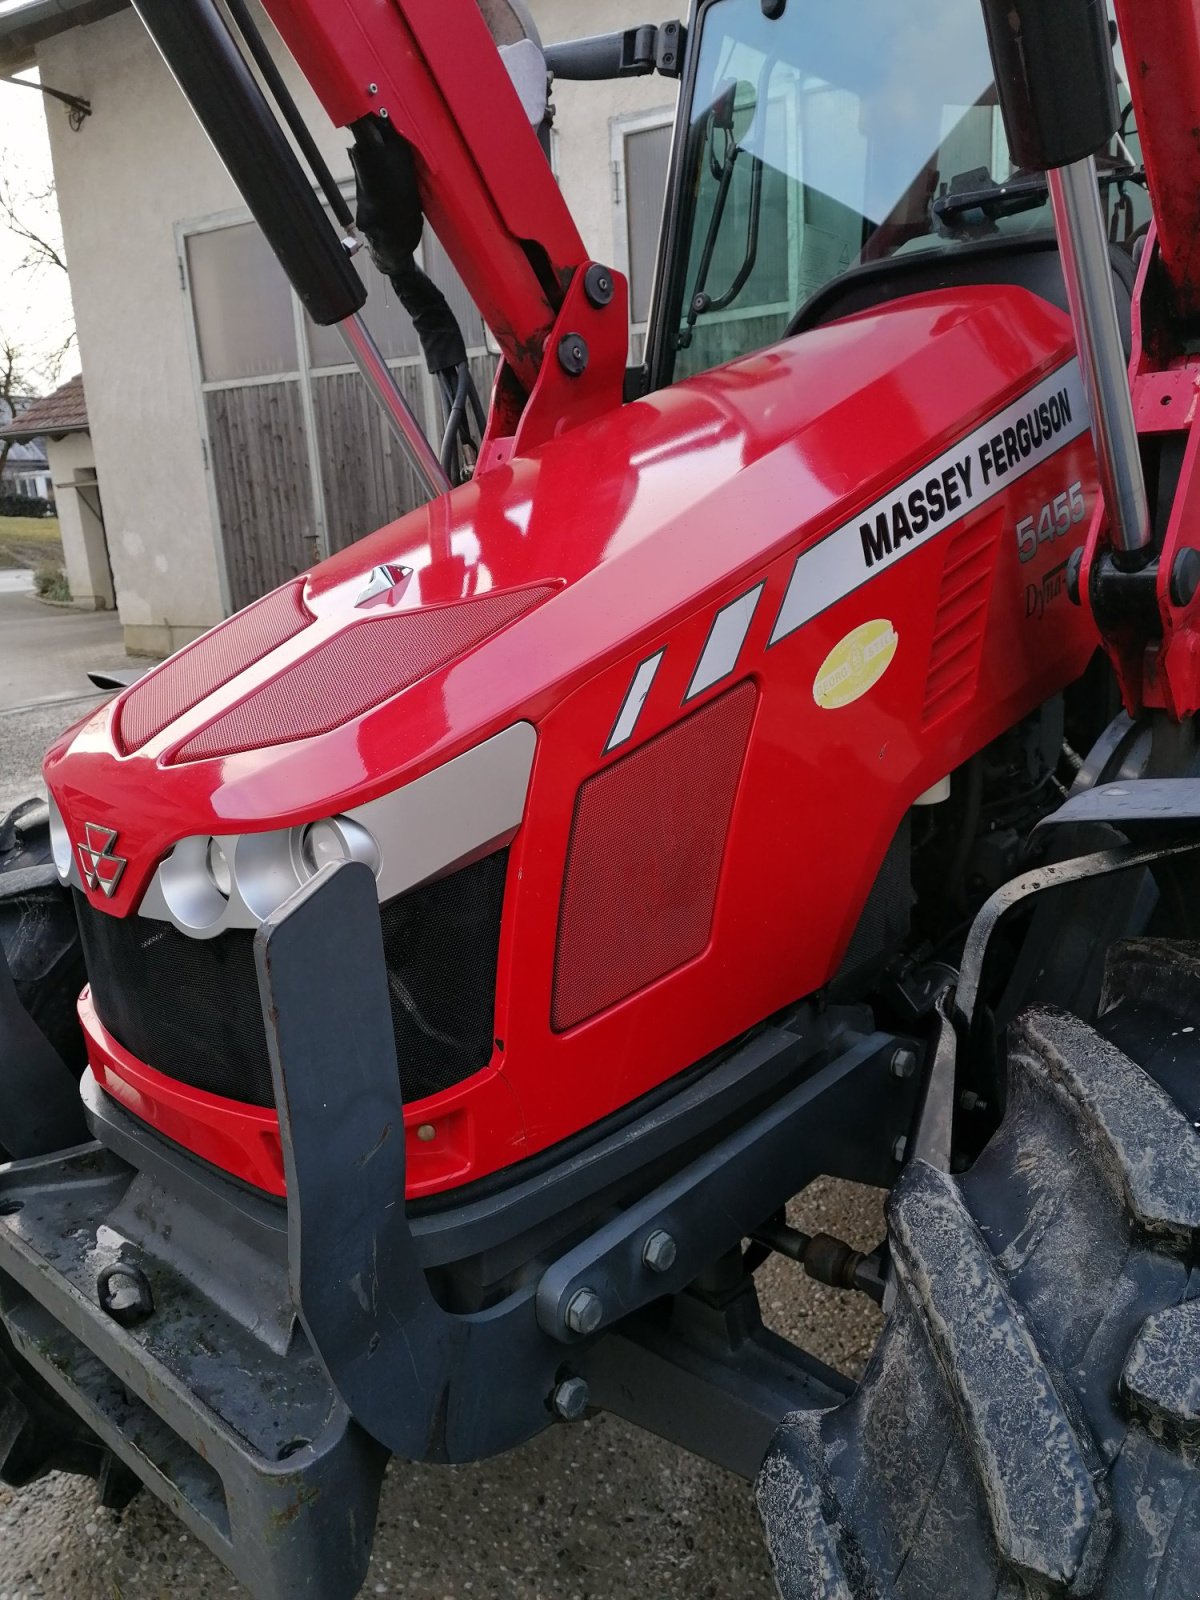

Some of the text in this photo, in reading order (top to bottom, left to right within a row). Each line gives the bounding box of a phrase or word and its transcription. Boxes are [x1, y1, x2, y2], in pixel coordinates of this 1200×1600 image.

[859, 387, 1073, 568] MASSEY FERGUSON
[1015, 479, 1086, 564] 5455
